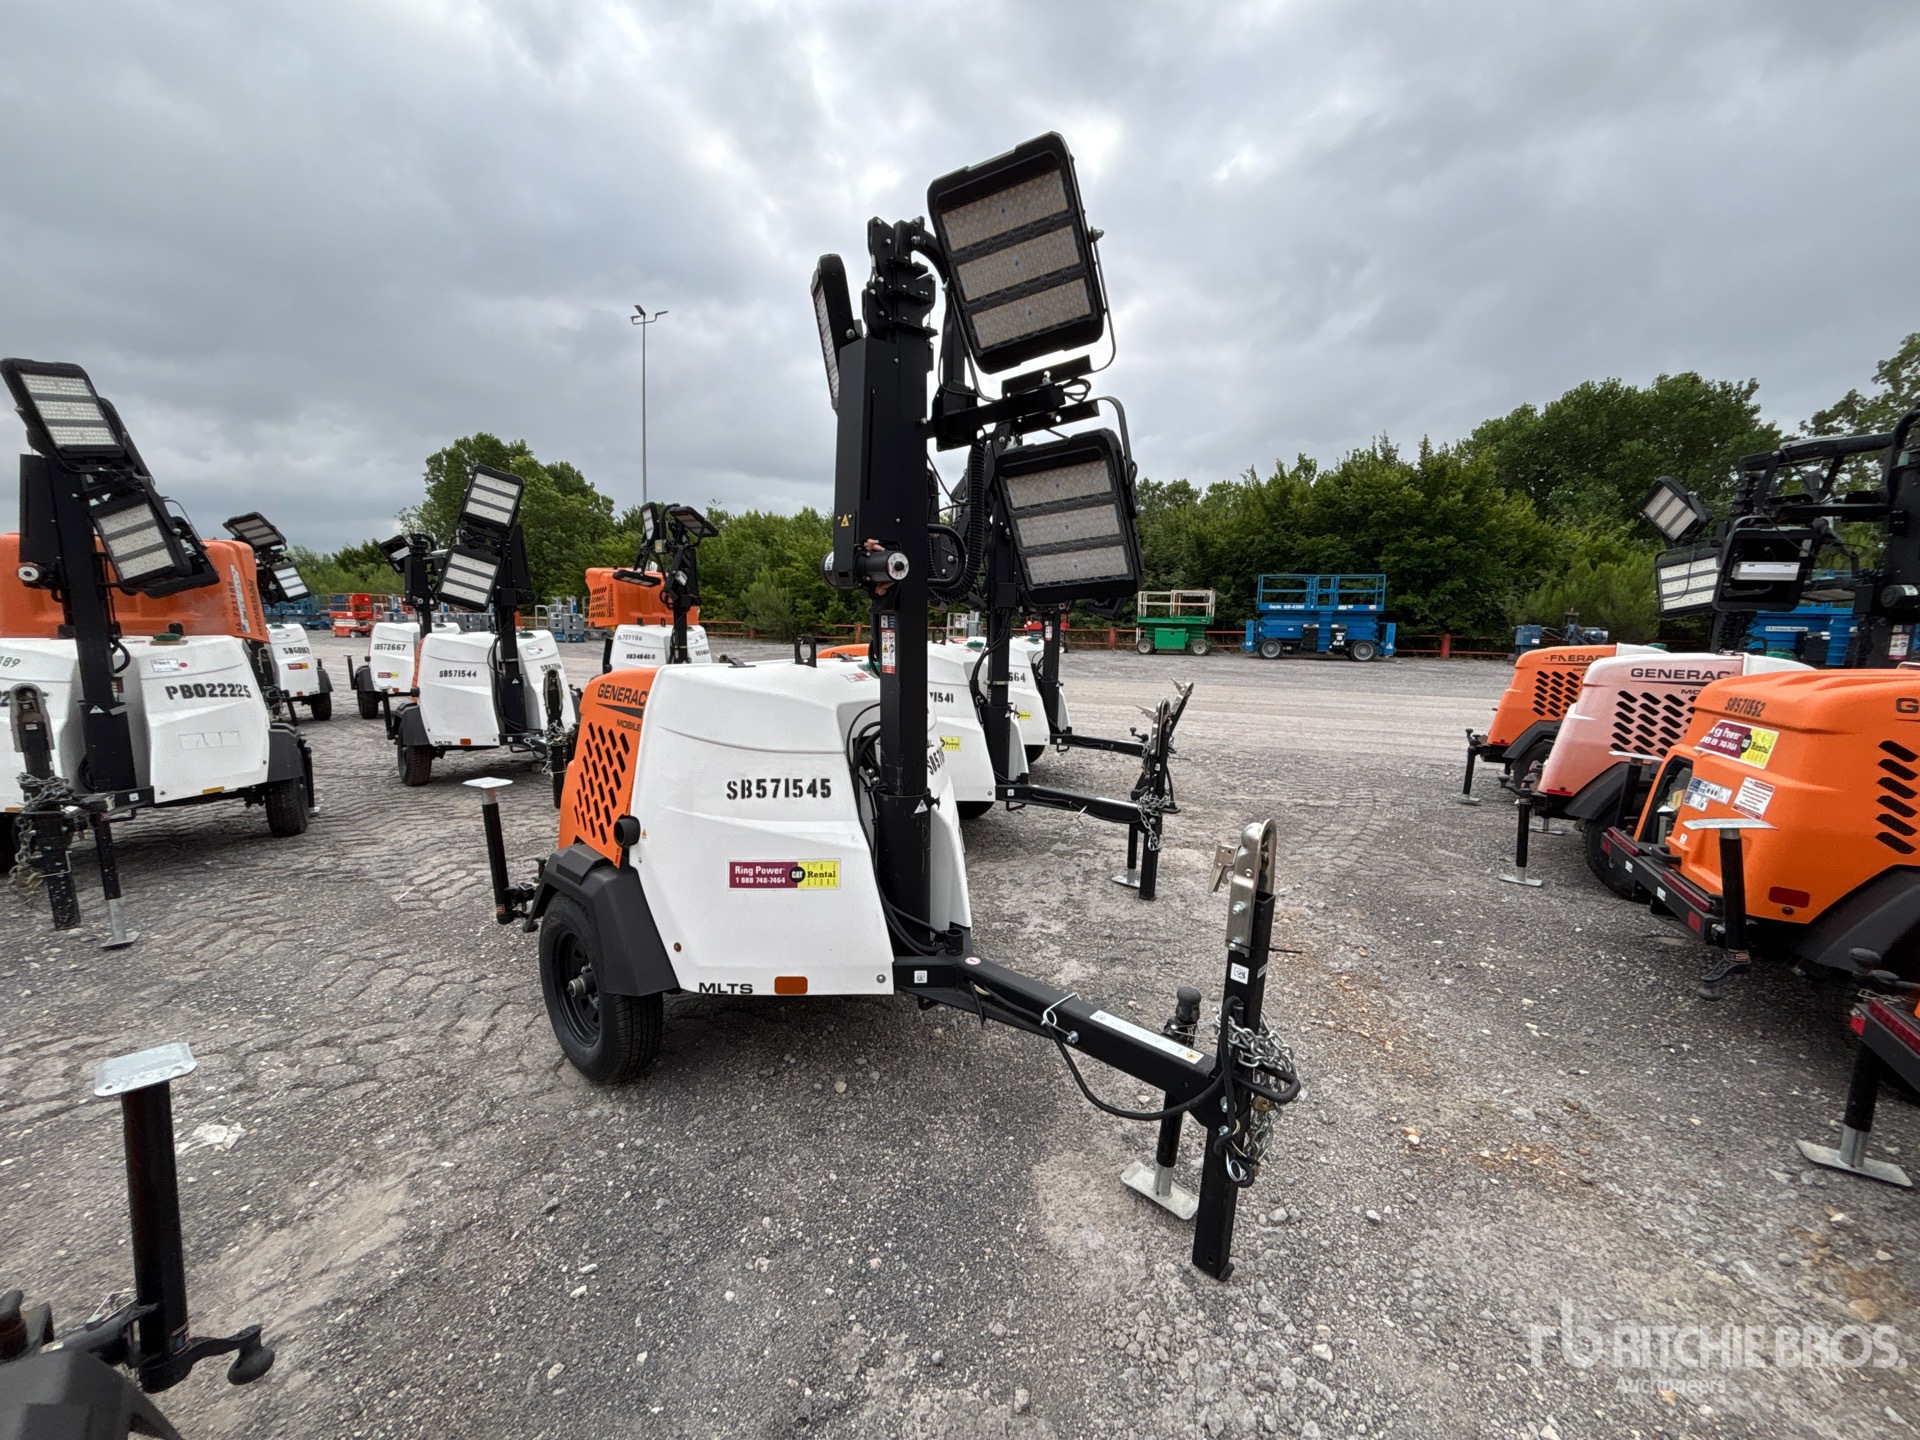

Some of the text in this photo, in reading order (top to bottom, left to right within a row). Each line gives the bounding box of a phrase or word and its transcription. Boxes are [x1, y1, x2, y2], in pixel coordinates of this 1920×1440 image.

[439, 670, 477, 678] SB571544
[1631, 668, 1731, 680] GENERAC
[597, 683, 650, 707] GENERAC
[726, 778, 831, 800] SB571545
[735, 866, 783, 876] Ring Power
[791, 871, 803, 879] CAT
[699, 982, 753, 994] MLTS
